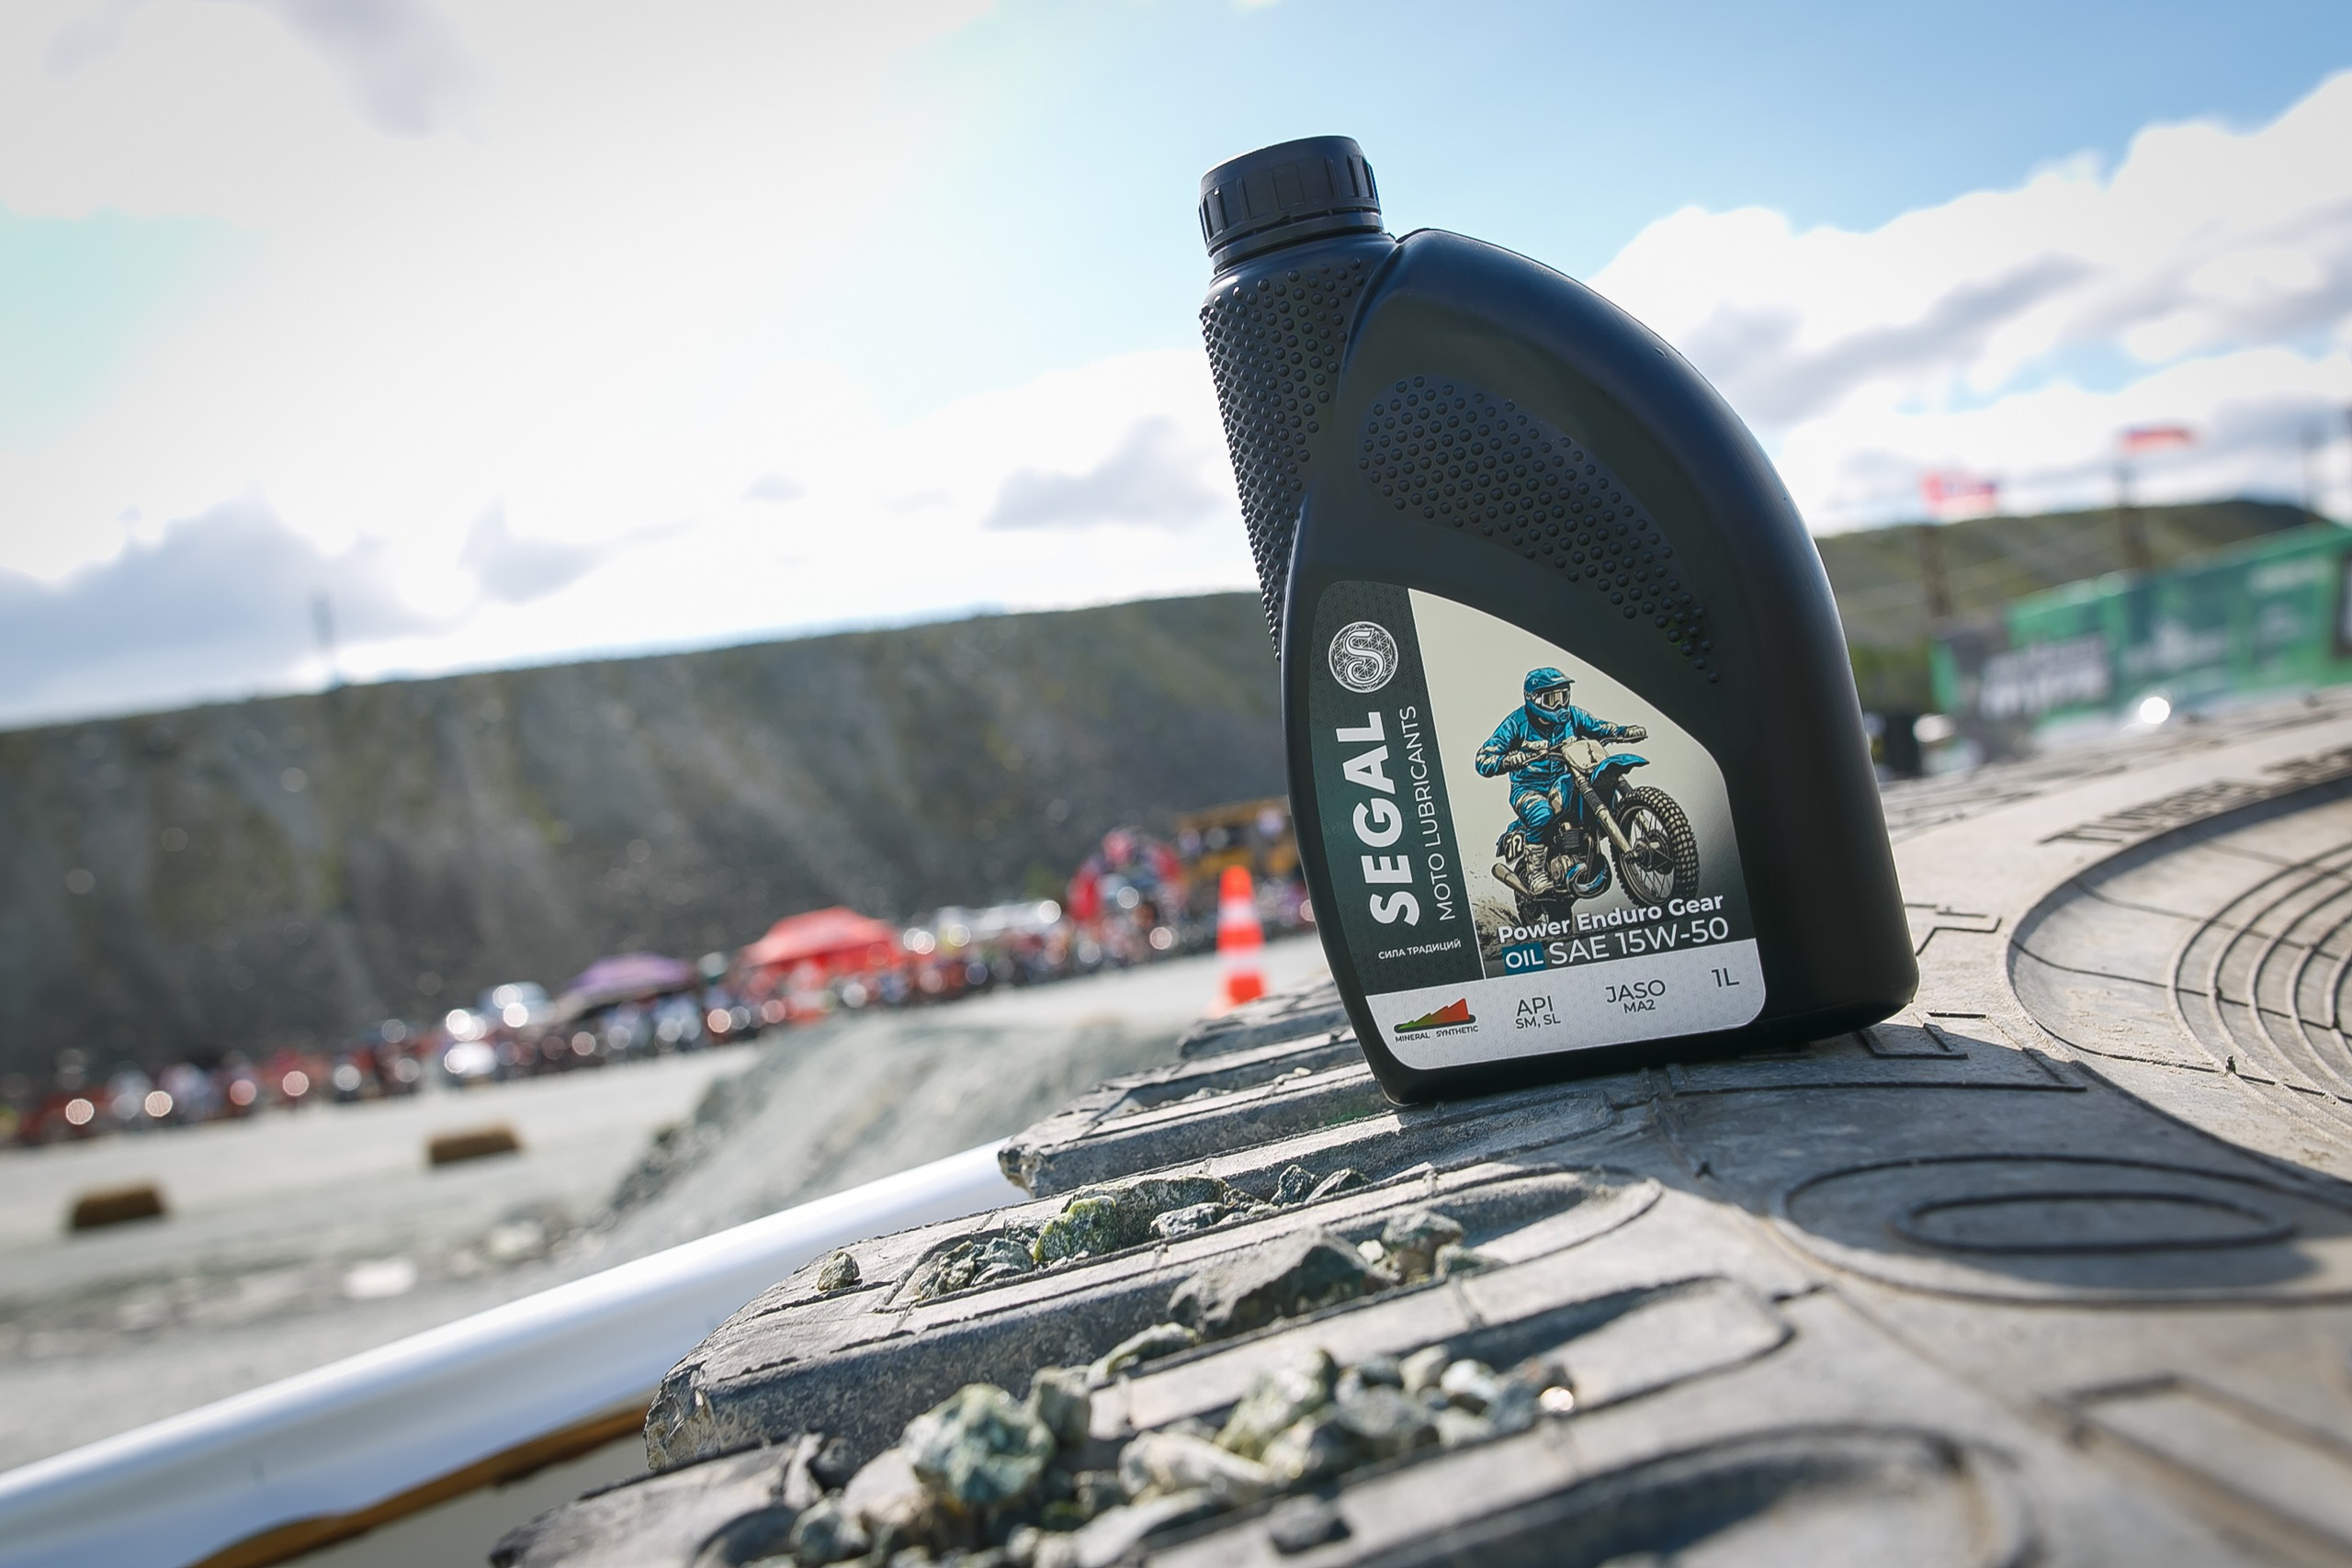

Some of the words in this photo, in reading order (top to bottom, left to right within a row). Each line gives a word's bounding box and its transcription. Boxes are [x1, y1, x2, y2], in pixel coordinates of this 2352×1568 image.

[1398, 705, 1442, 847] LUBRICANTS
[1335, 711, 1420, 927] SEGAL
[1426, 852, 1456, 921] MOTO
[1498, 919, 1570, 944] Power
[1577, 905, 1662, 932] Enduro
[1668, 895, 1724, 917] Gear
[1378, 948, 1406, 960] СИЛА
[1407, 939, 1462, 954] ТРАДИЦИЙ
[1505, 948, 1544, 969] OIL
[1548, 934, 1610, 965] SAE
[1614, 917, 1729, 956] 15W-50
[1711, 967, 1740, 988] 1L
[1606, 979, 1667, 1004] JASO
[1517, 995, 1555, 1017] API
[1623, 998, 1656, 1014] MA2
[1516, 1017, 1541, 1030] SM,
[1544, 1013, 1561, 1026] SL
[1395, 1031, 1430, 1043] MINERAL
[1436, 1024, 1479, 1038] SYNTHETIC
